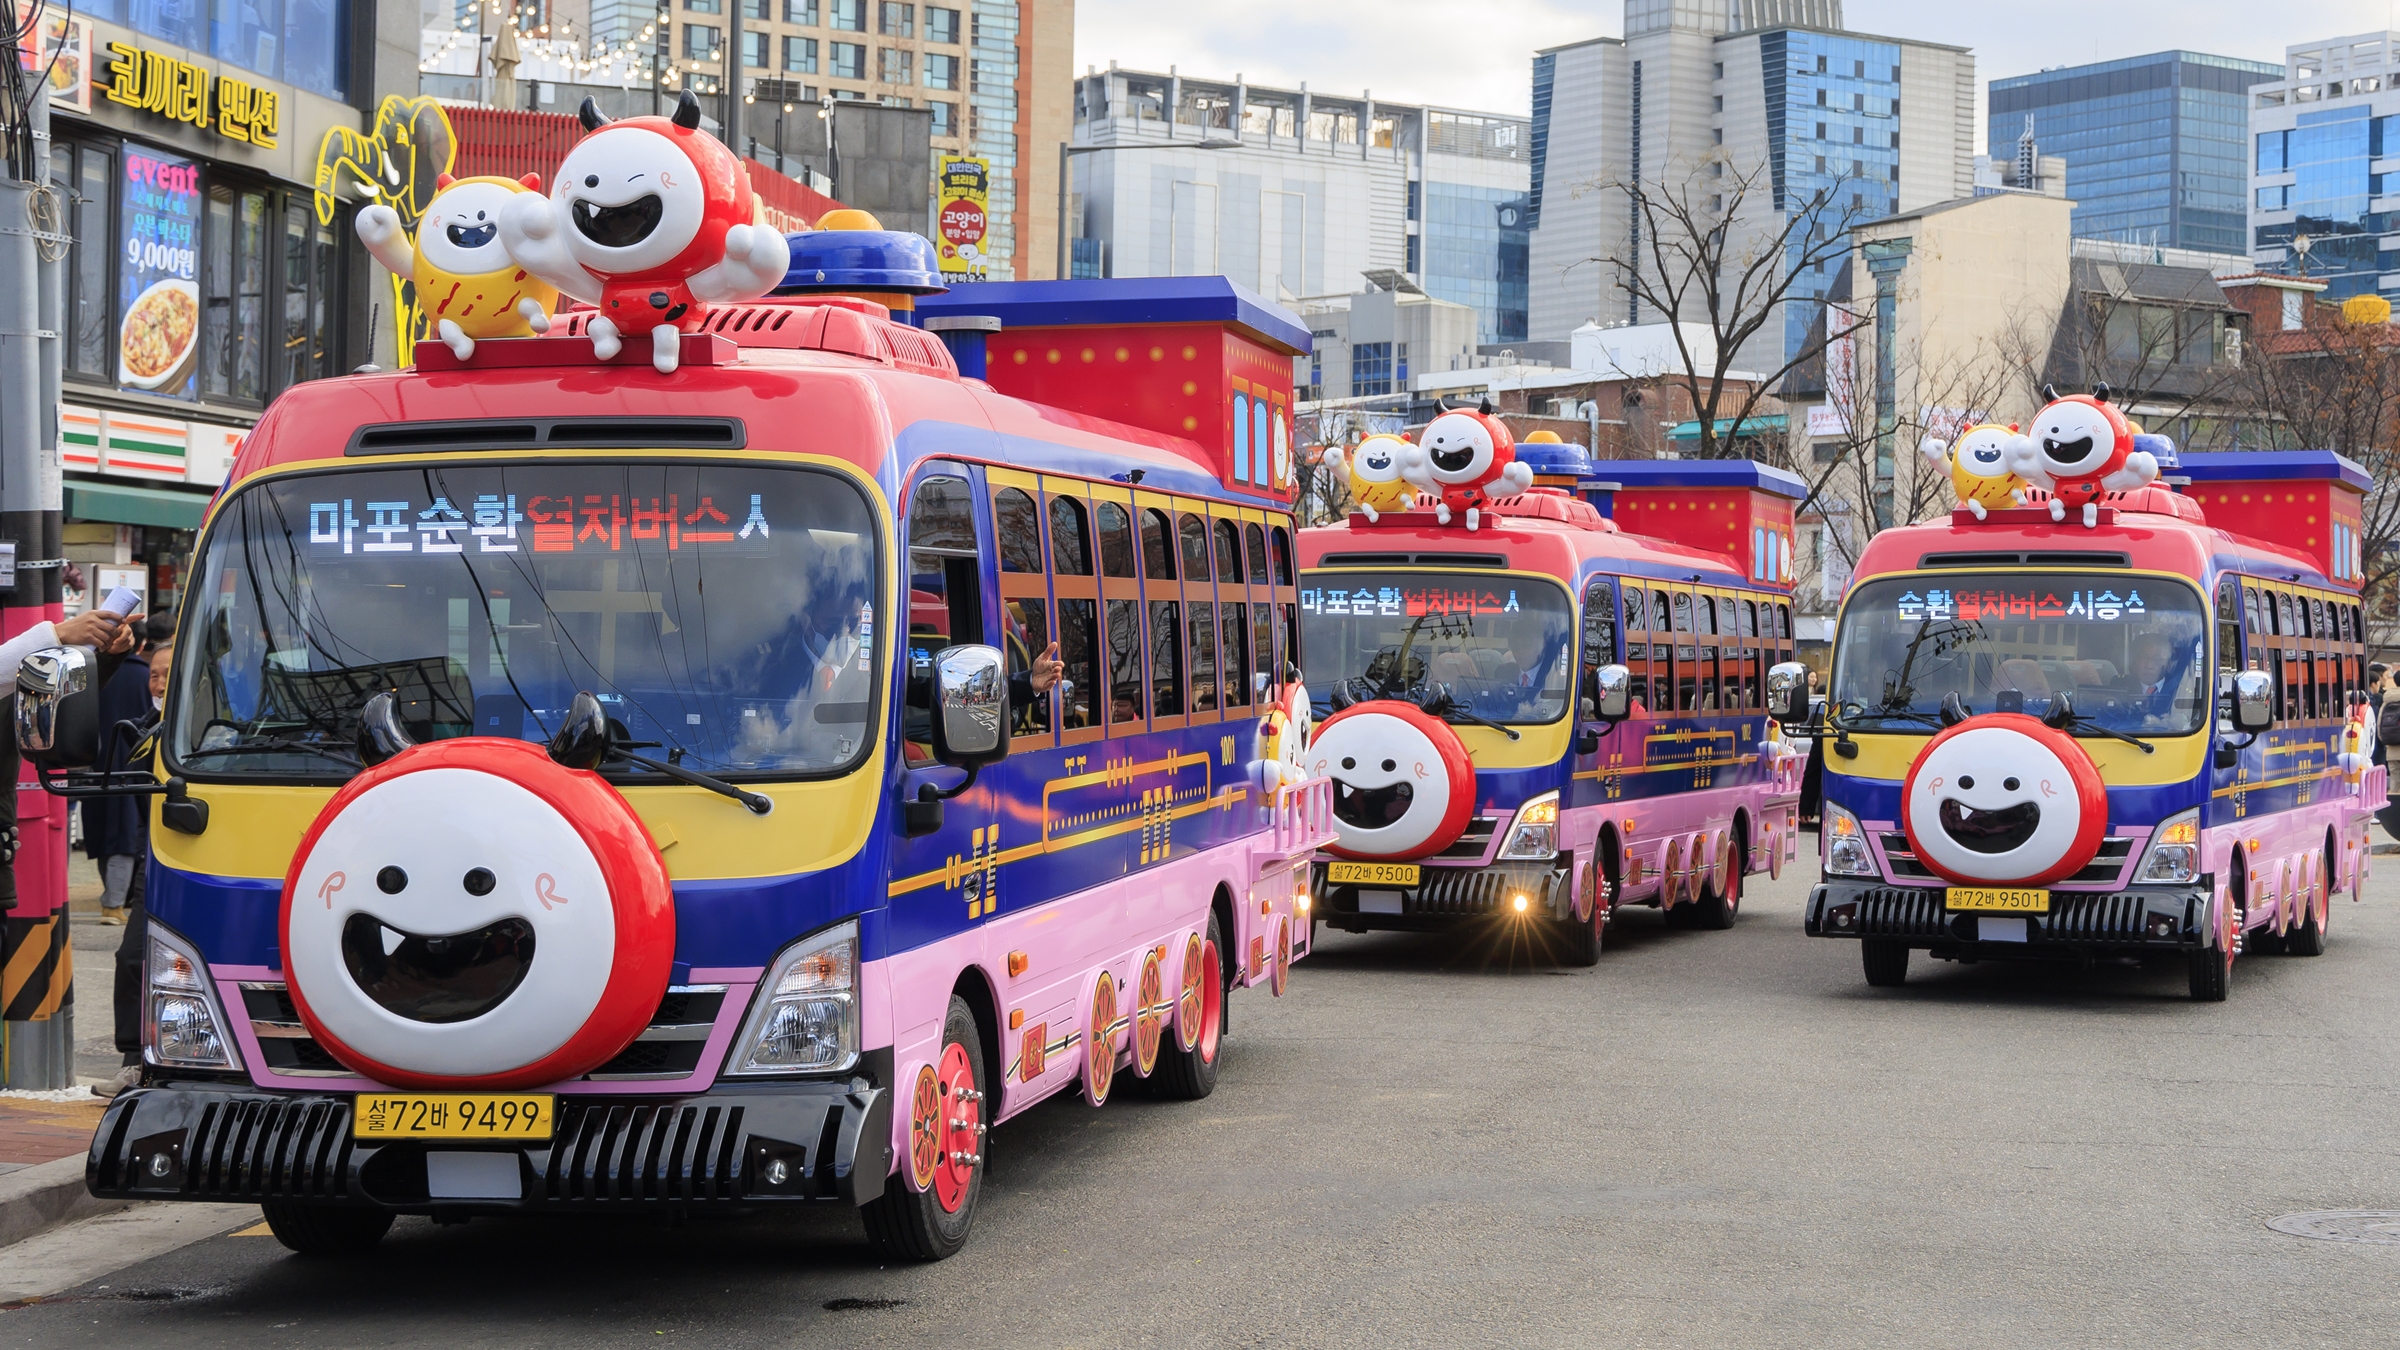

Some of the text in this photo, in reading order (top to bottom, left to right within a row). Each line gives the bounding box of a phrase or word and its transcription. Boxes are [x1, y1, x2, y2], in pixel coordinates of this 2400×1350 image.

[106, 41, 280, 150] 코끼리 맨션
[127, 153, 200, 197] event
[157, 218, 192, 246] 파스타
[942, 211, 984, 229] 고양이
[127, 238, 195, 279] 9,000원
[1220, 735, 1236, 767] 1001
[1375, 866, 1413, 881] 9500
[1999, 891, 2039, 908] 9501
[458, 1100, 540, 1132] 9499
